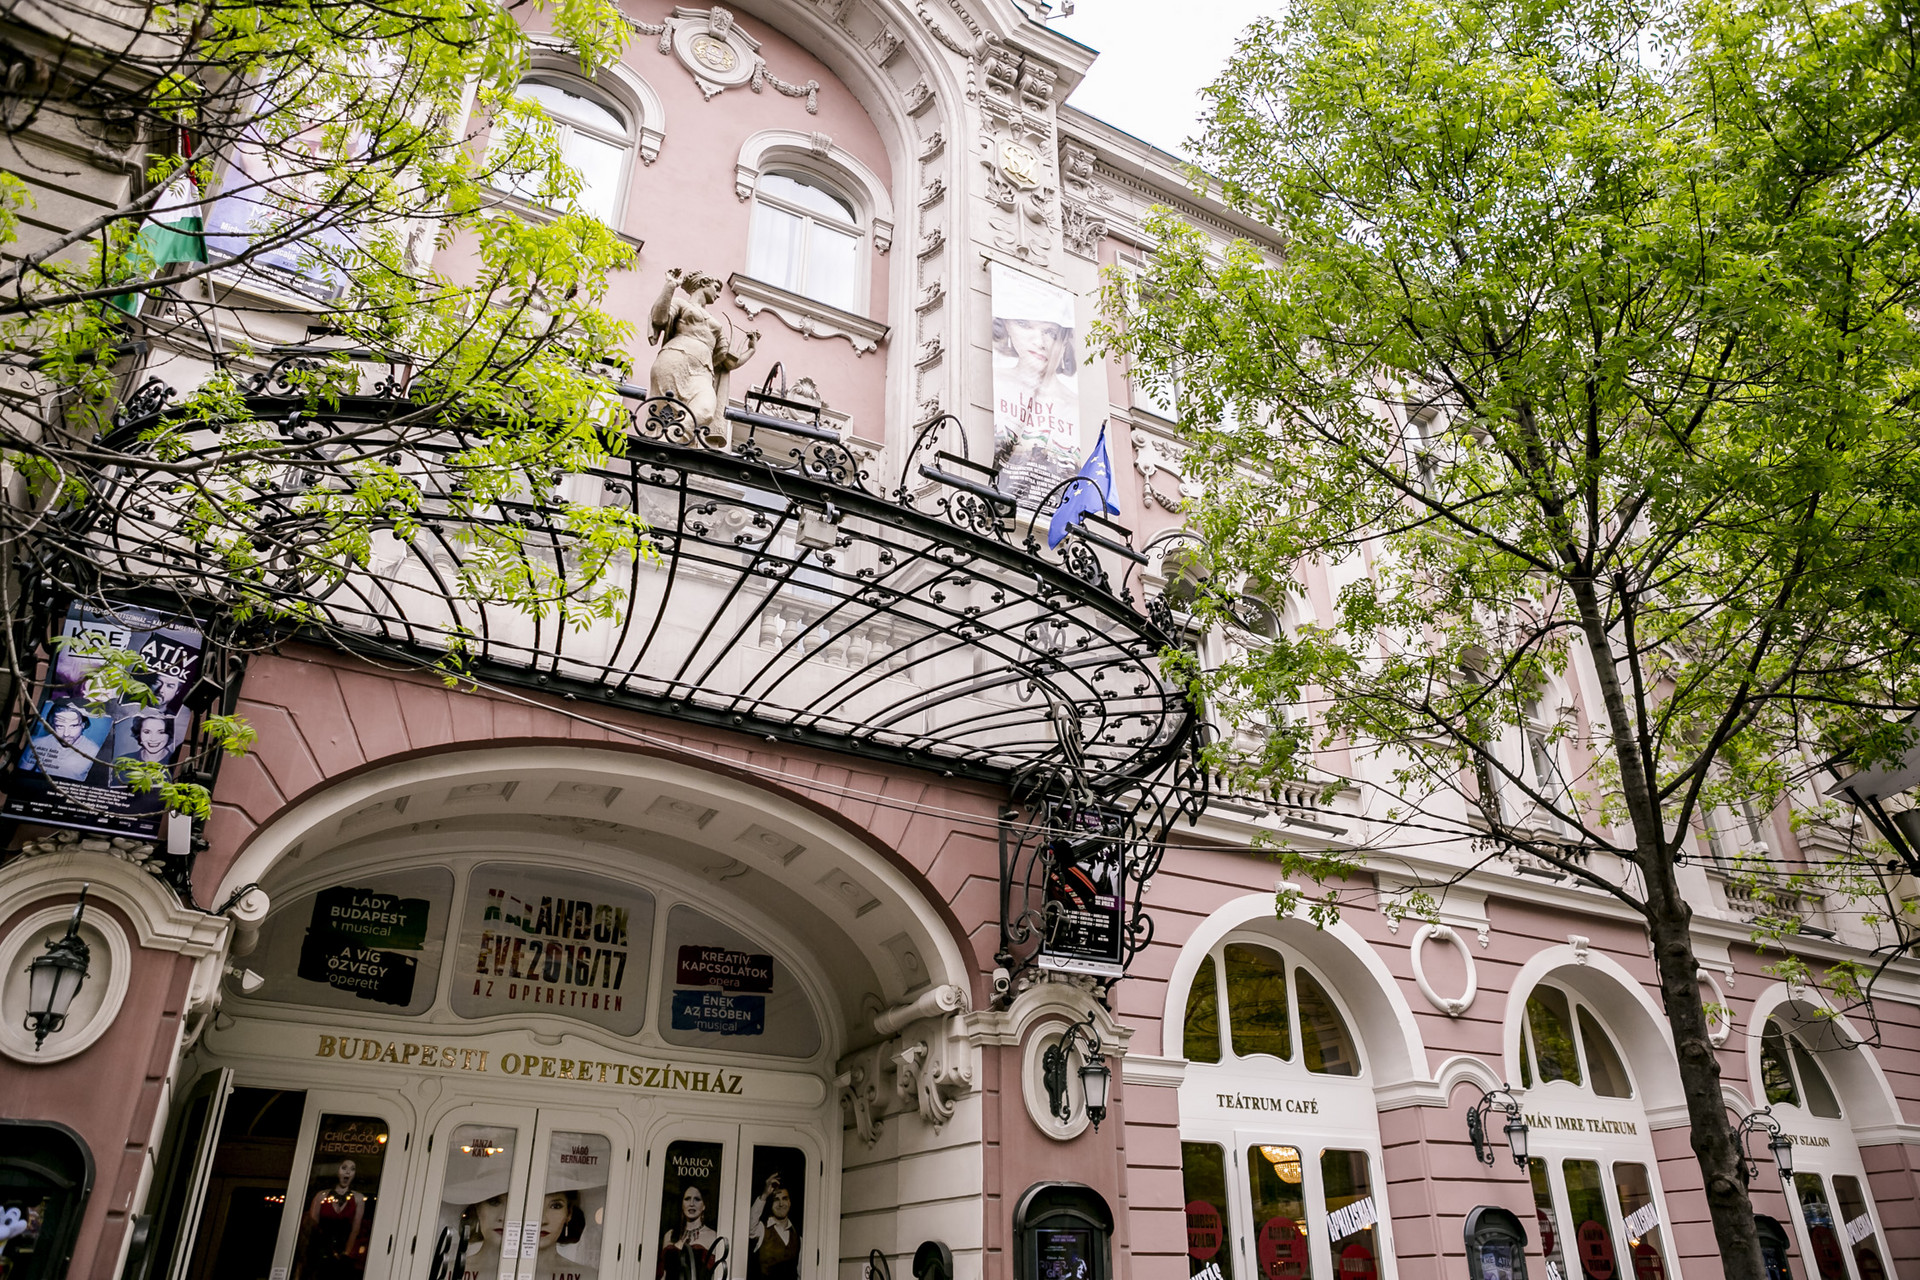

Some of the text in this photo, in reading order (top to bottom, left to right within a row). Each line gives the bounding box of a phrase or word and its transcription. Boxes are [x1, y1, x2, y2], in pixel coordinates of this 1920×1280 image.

[1019, 392, 1053, 415] LADY
[1000, 398, 1074, 436] BUDAPEST
[142, 640, 199, 668] ATÍV
[352, 896, 391, 911] LADY
[331, 906, 407, 925] BUDAPEST
[341, 922, 391, 936] musical
[341, 947, 381, 963] A VÍG
[702, 951, 750, 966] KREATÍV
[327, 955, 388, 978] ÖZVEGY
[682, 960, 768, 979] KAPCSOLATOK
[329, 974, 379, 990] operett
[709, 977, 740, 988] opera
[473, 979, 622, 1012] AZ OPERETTBEN
[703, 993, 734, 1008] ÉNEK
[683, 1005, 751, 1021] AZ ESŐBEN
[696, 1020, 738, 1031] musical
[316, 1034, 744, 1095] BUDAPESTI OPERETTSZÍNHÁZ
[1216, 1092, 1319, 1114] TEÁTRUM CAFÉ
[1553, 1116, 1585, 1131] IMRE
[1586, 1117, 1638, 1135] TEÁTRUM
[471, 1139, 493, 1148] JANZA
[1799, 1135, 1831, 1147] SZALON
[571, 1145, 589, 1155] VÁGÓ
[560, 1154, 598, 1166] BERNADETT
